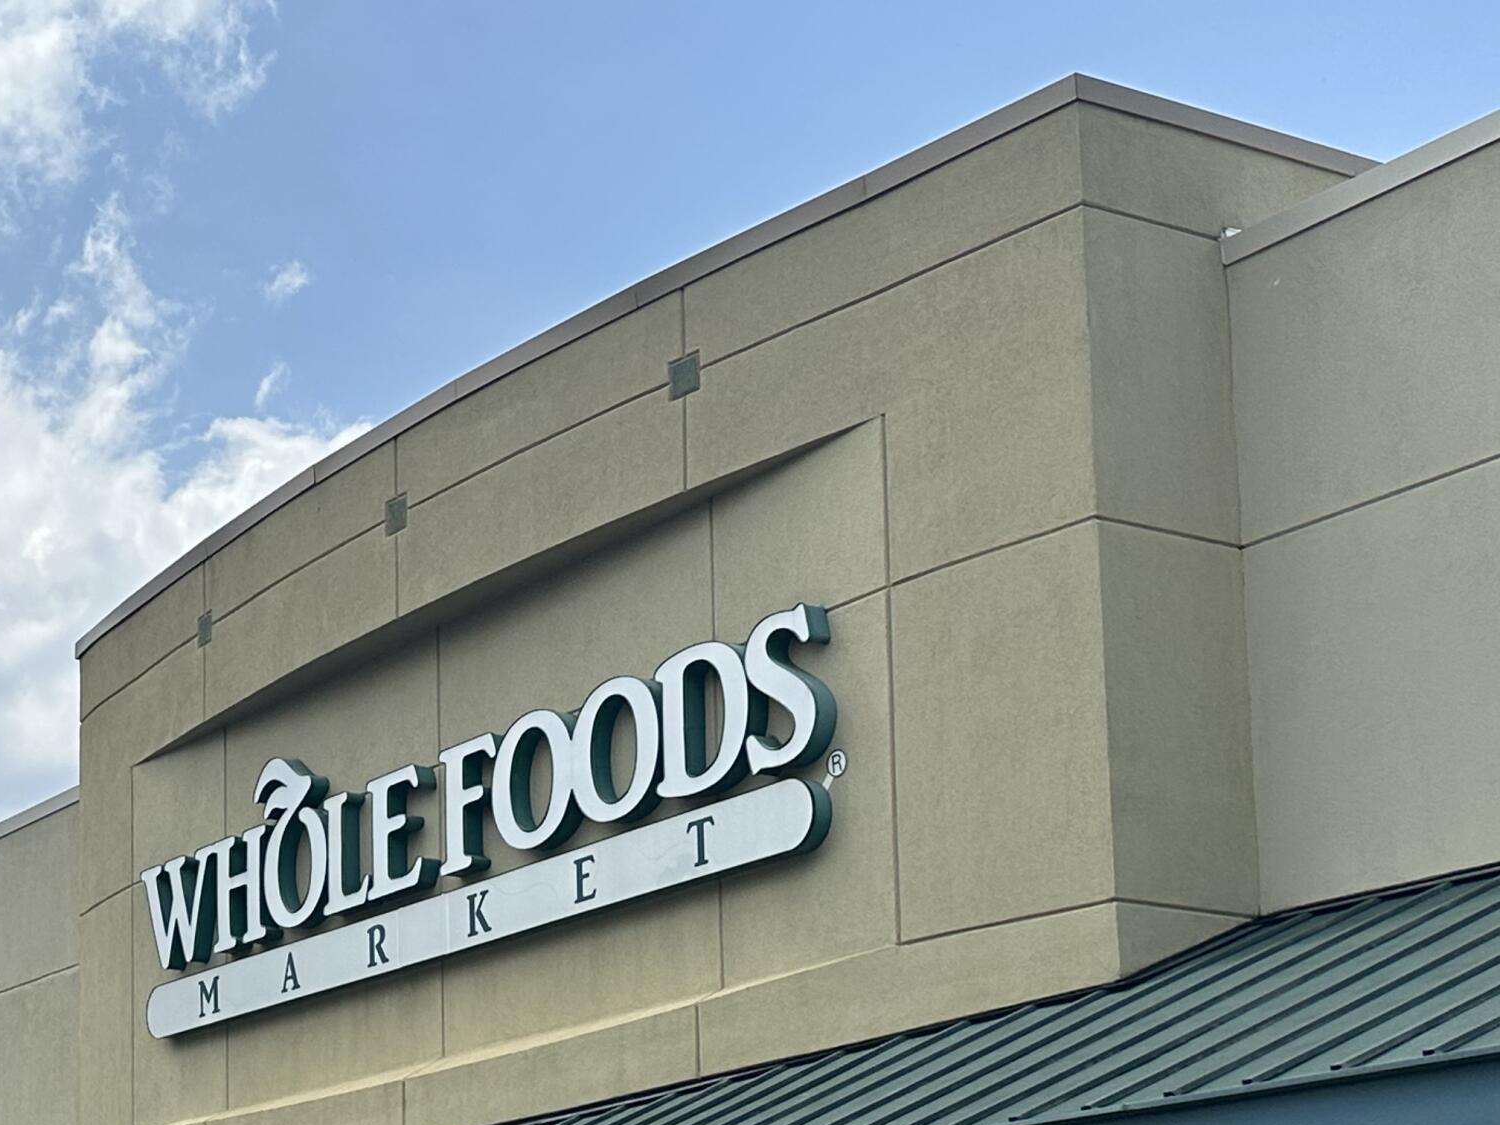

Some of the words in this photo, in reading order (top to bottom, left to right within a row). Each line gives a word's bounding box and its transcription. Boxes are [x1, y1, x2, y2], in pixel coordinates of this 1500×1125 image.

[141, 758, 437, 970] WHOLE
[440, 603, 828, 876] FOODS
[199, 816, 716, 1018] MARKET
